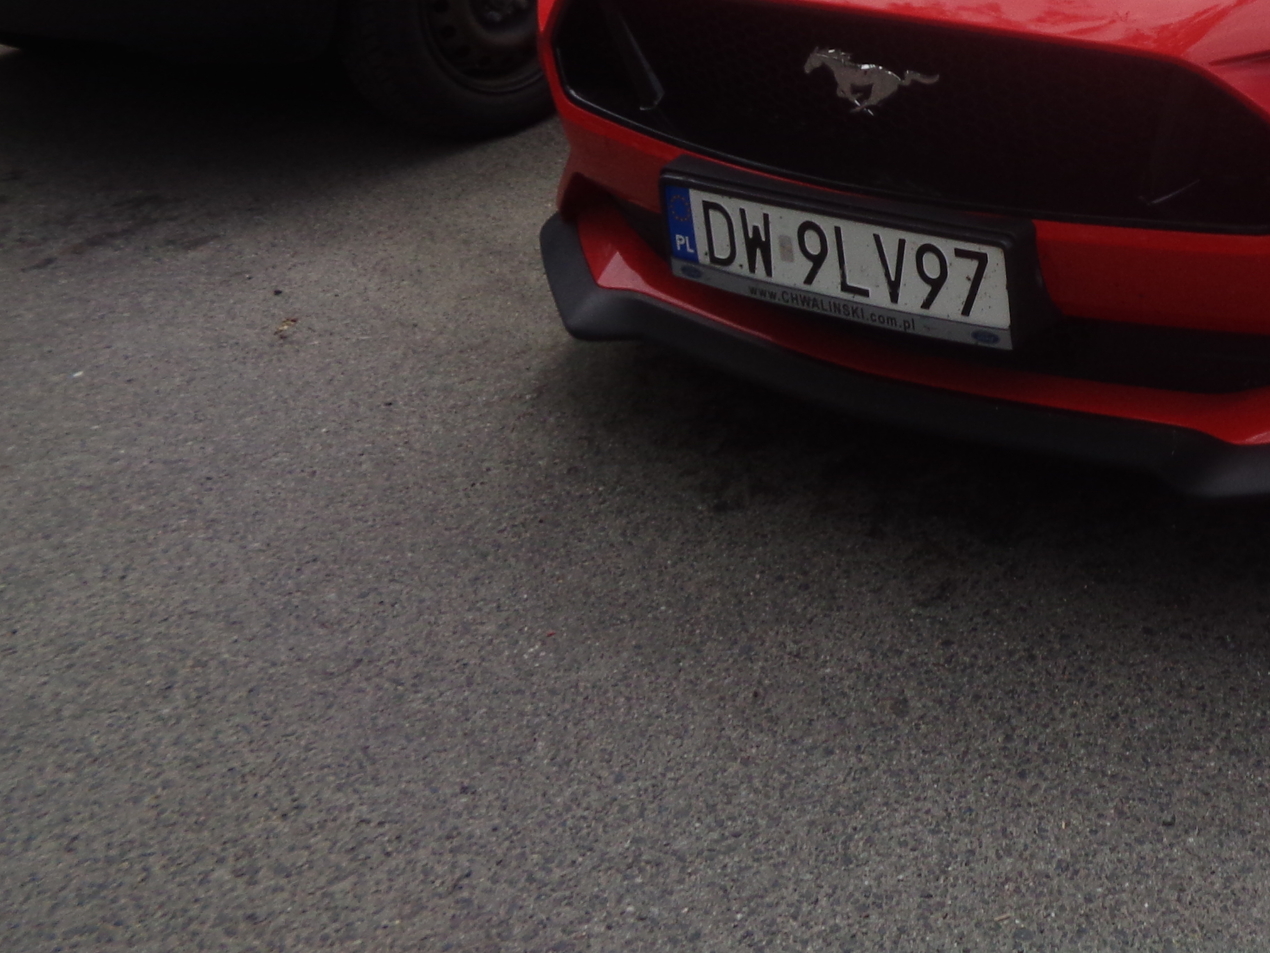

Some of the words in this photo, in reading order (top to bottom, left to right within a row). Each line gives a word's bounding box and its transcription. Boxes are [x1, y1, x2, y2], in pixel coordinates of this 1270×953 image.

[675, 234, 695, 254] PL
[702, 200, 773, 279] DW
[796, 220, 989, 317] 9LV97
